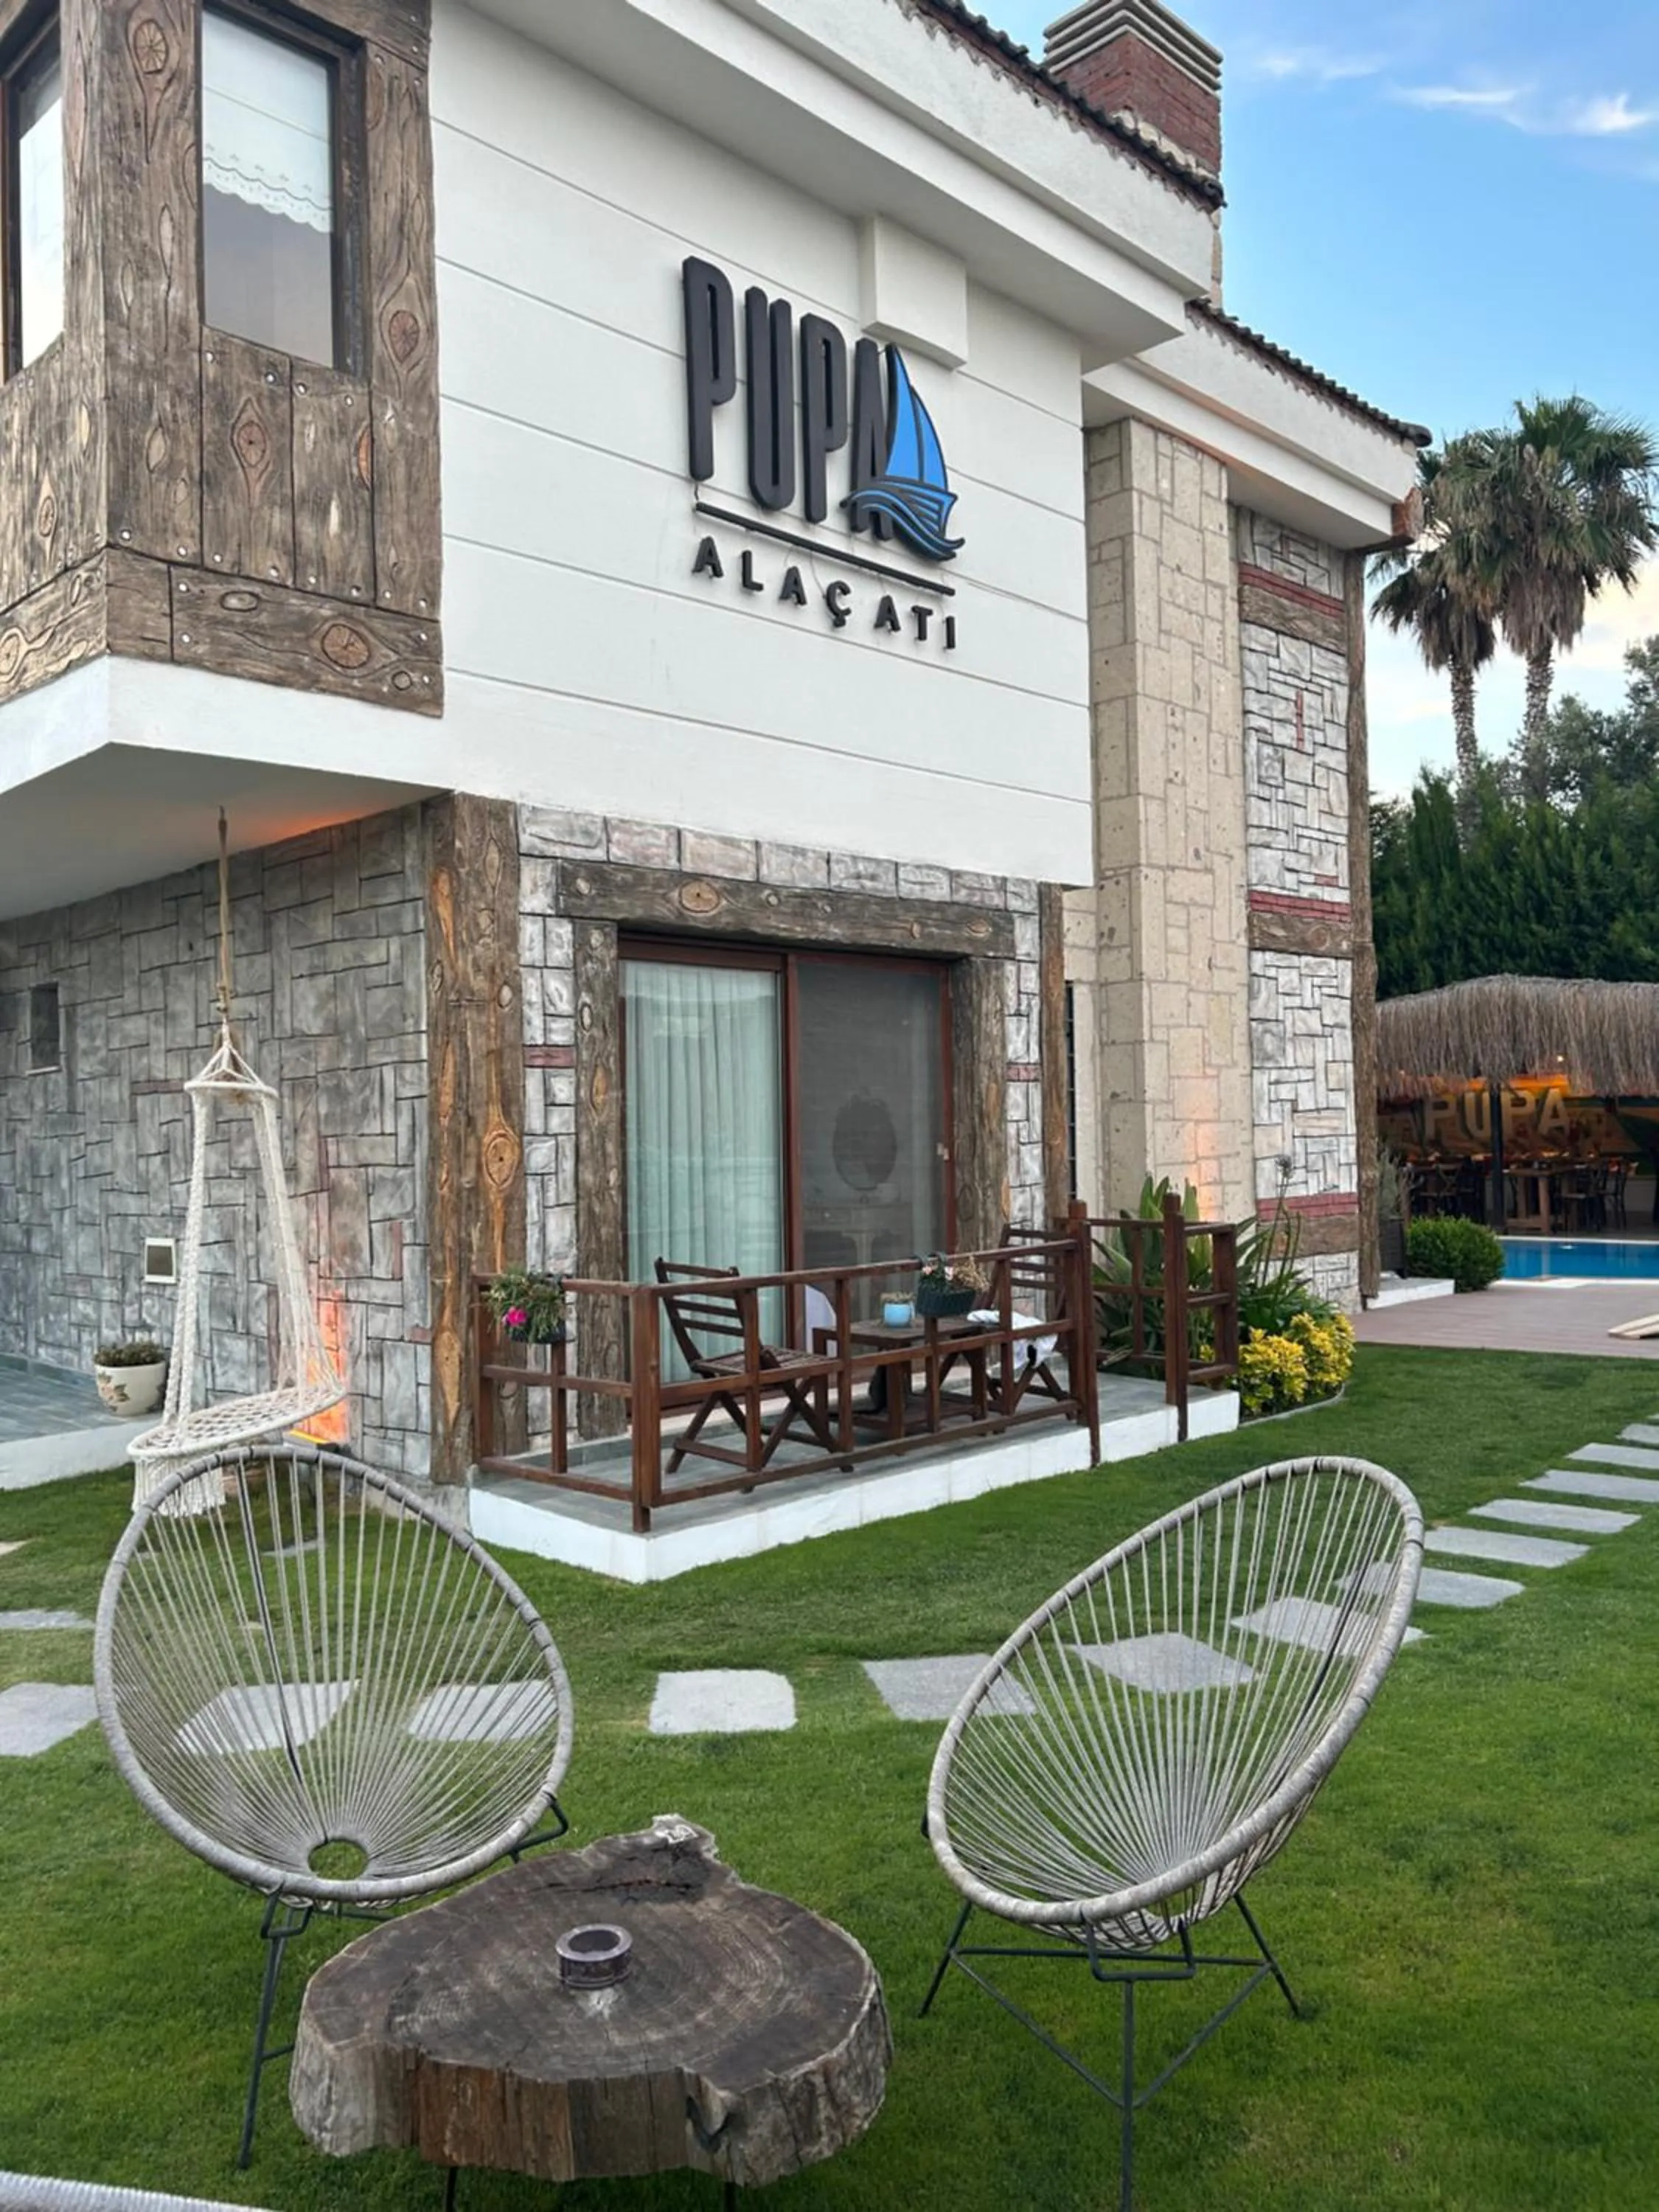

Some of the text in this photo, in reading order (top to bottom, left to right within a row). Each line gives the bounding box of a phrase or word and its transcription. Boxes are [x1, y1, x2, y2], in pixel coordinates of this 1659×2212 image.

[682, 256, 897, 541] PUPA
[692, 535, 956, 649] ALAÇATI
[1424, 1088, 1570, 1144] PUPA
